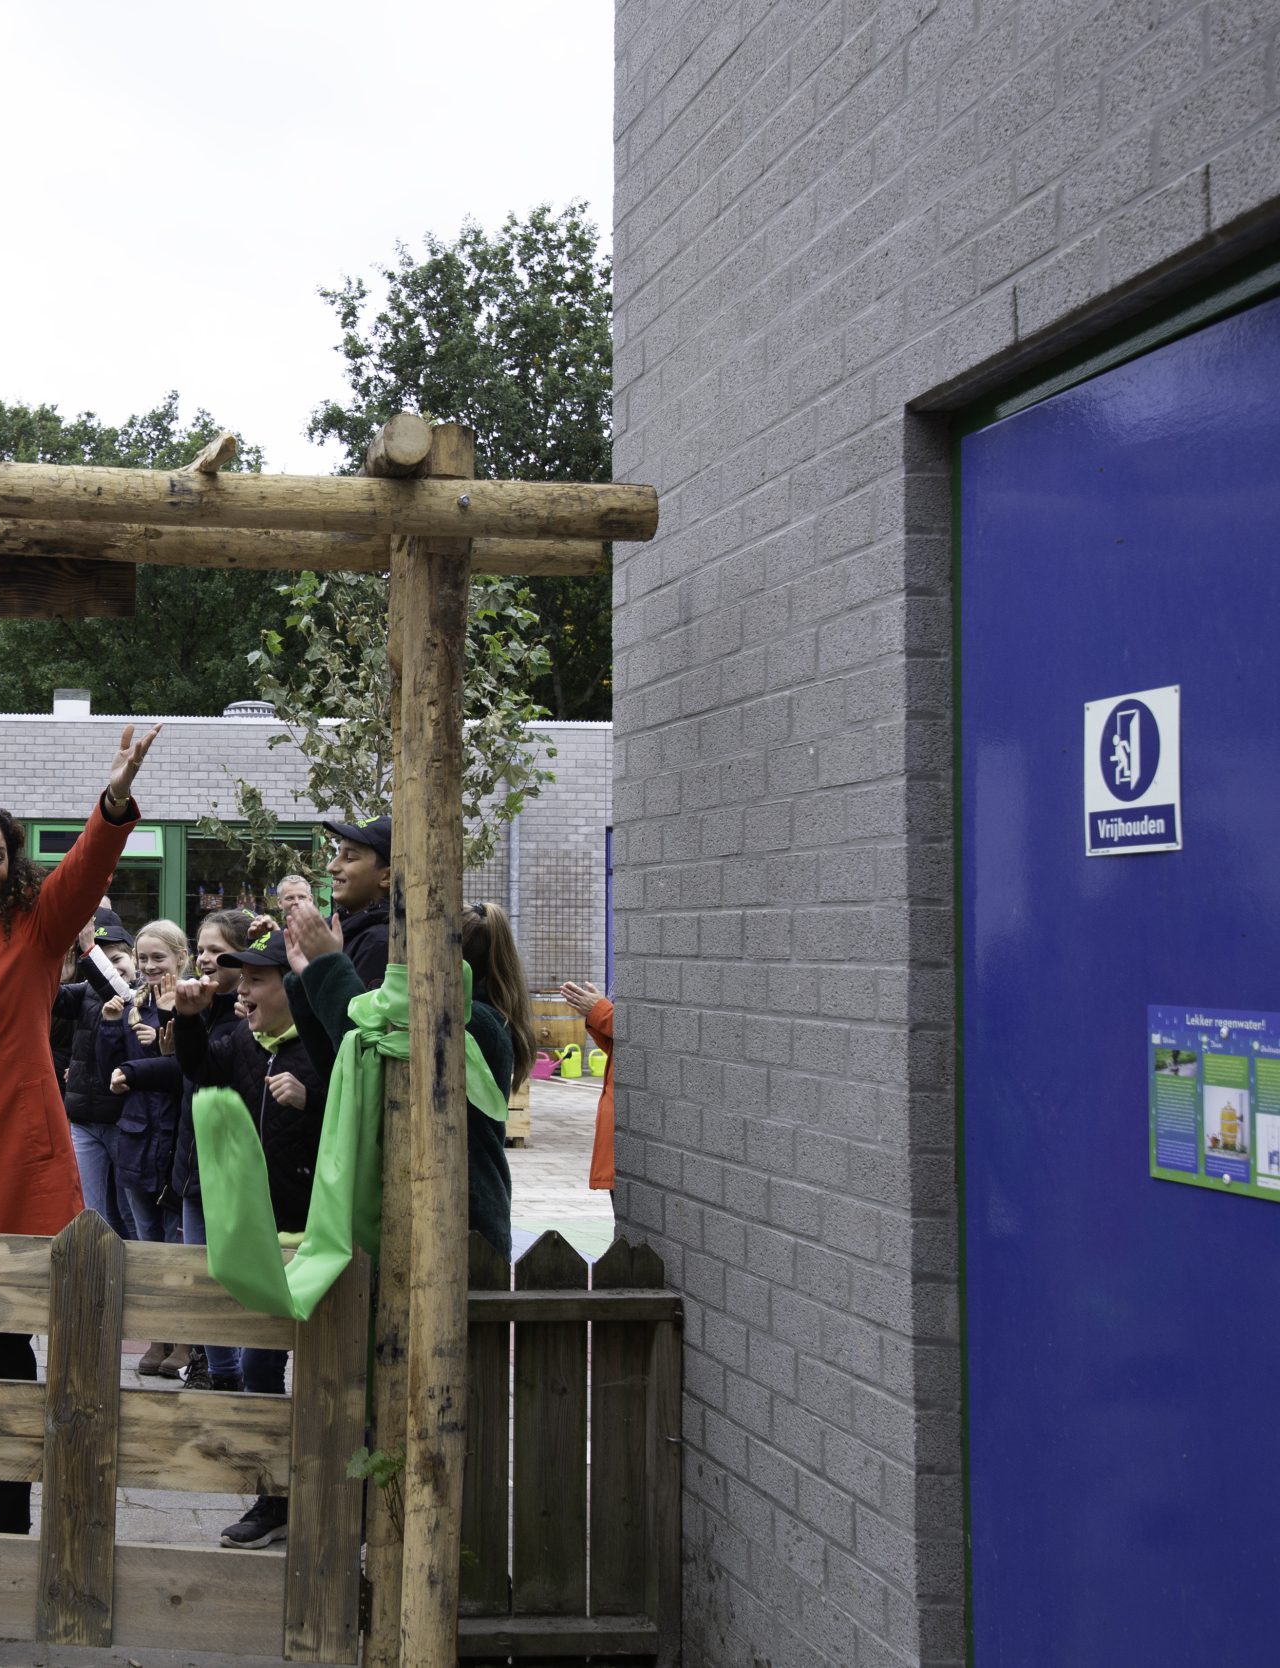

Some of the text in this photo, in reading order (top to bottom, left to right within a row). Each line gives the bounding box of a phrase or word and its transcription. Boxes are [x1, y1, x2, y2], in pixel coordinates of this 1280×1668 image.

[1097, 814, 1165, 842] Vrijhouden
[1185, 1013, 1266, 1031] Lekker regenwater!
